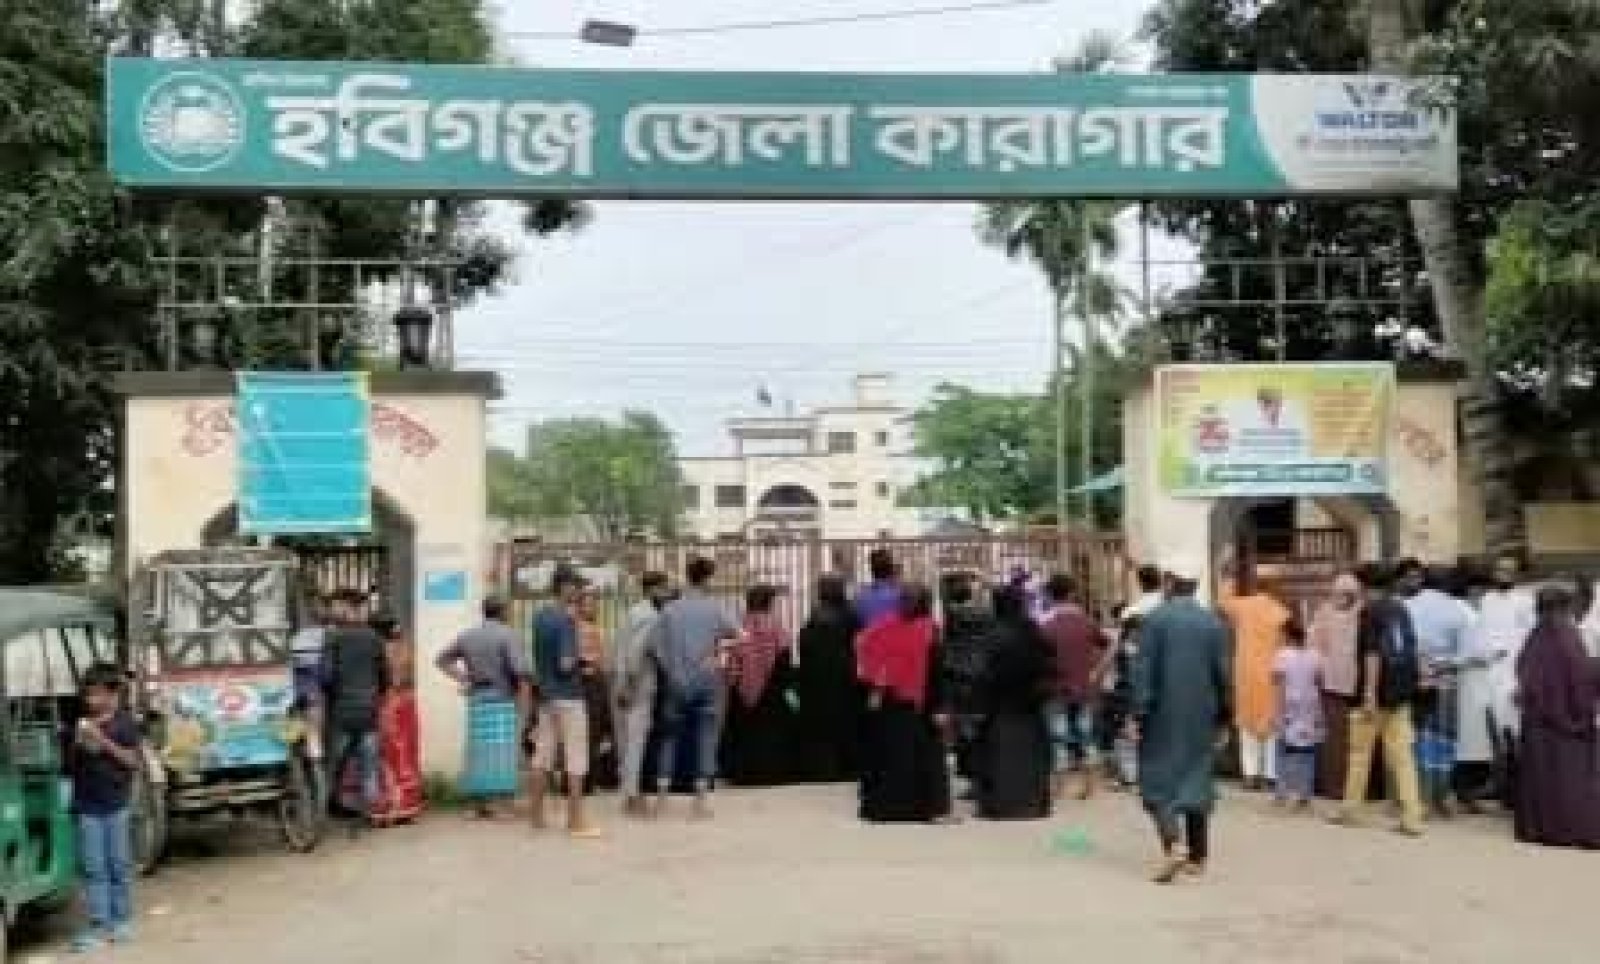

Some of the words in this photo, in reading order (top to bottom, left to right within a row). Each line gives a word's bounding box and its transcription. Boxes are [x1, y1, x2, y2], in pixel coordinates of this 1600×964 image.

[266, 73, 595, 178] হবিগঞ্জ
[623, 104, 852, 169] জেলা
[872, 106, 1229, 172] কারাগার
